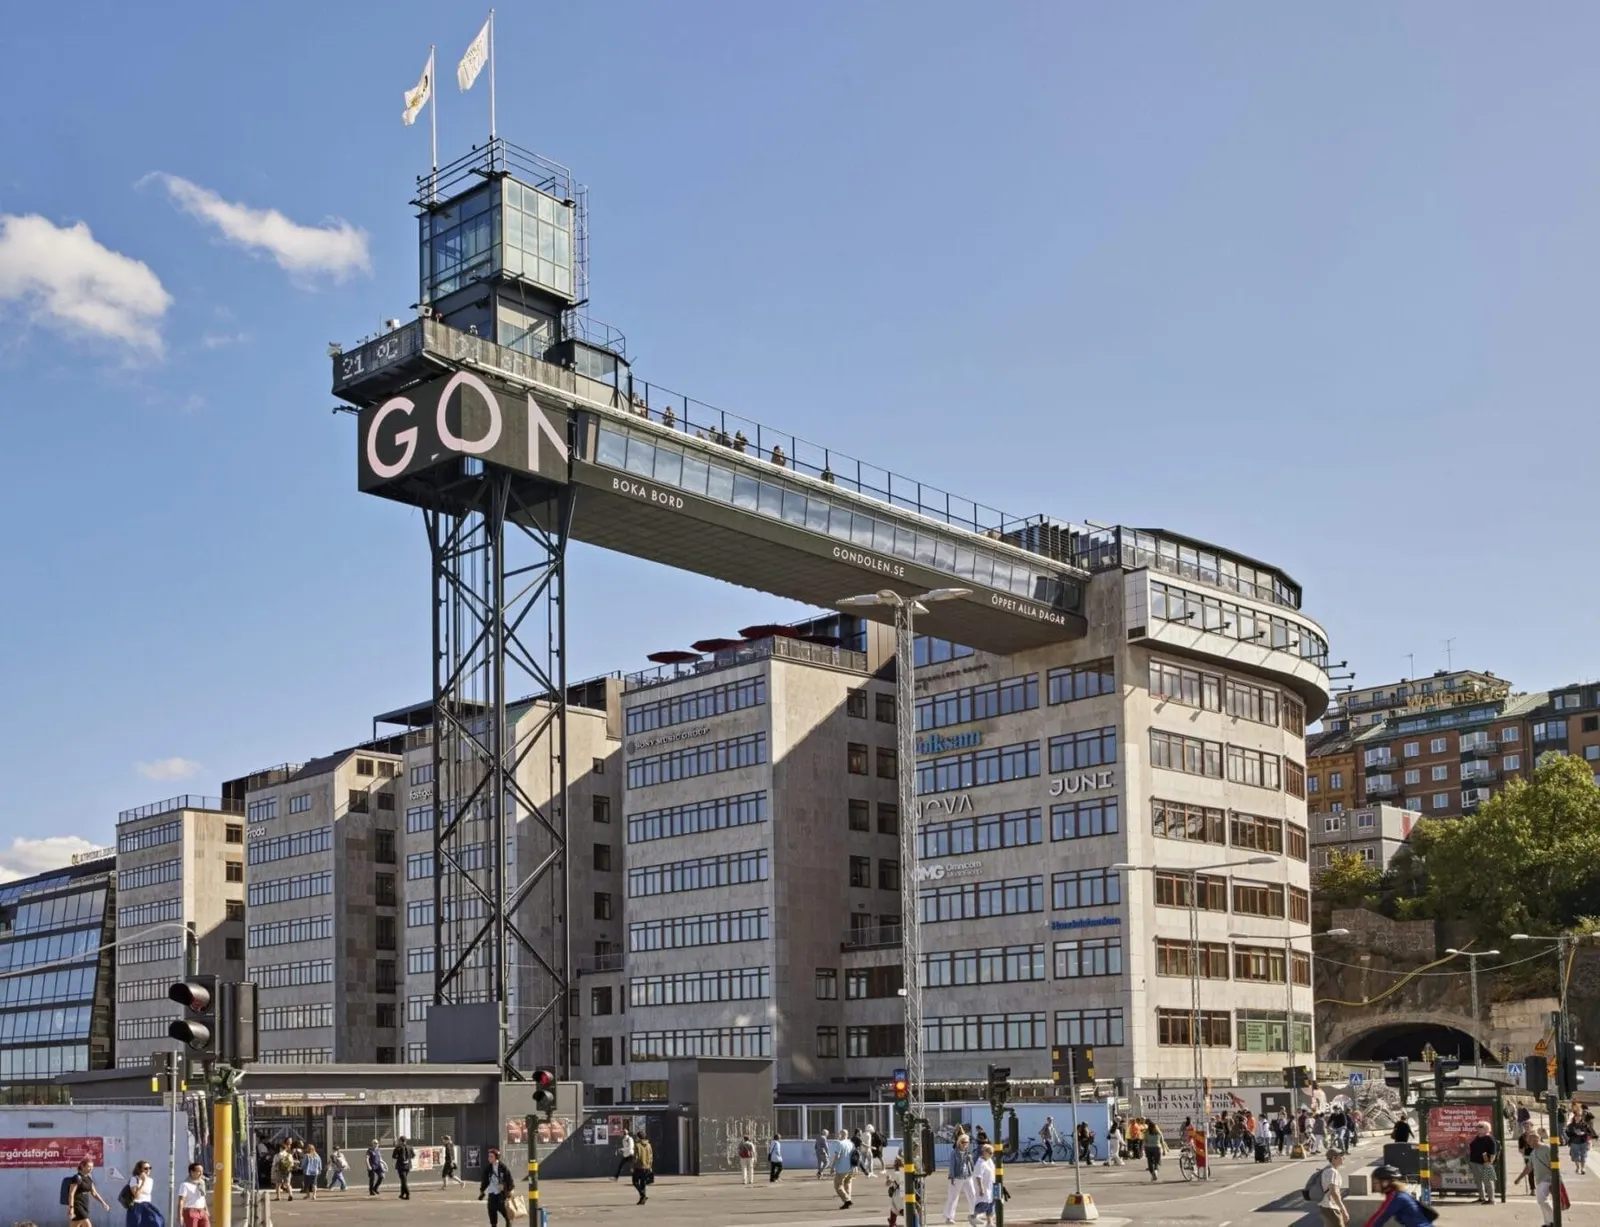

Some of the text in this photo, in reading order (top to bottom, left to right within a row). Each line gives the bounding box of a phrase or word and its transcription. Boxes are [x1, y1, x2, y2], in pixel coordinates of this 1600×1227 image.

[612, 477, 684, 509] BOKA BORD
[833, 546, 905, 577] GONDOLEN.SE
[991, 593, 1066, 626] ÖPPET ALLA DAGAR
[1048, 771, 1114, 796] JUNI
